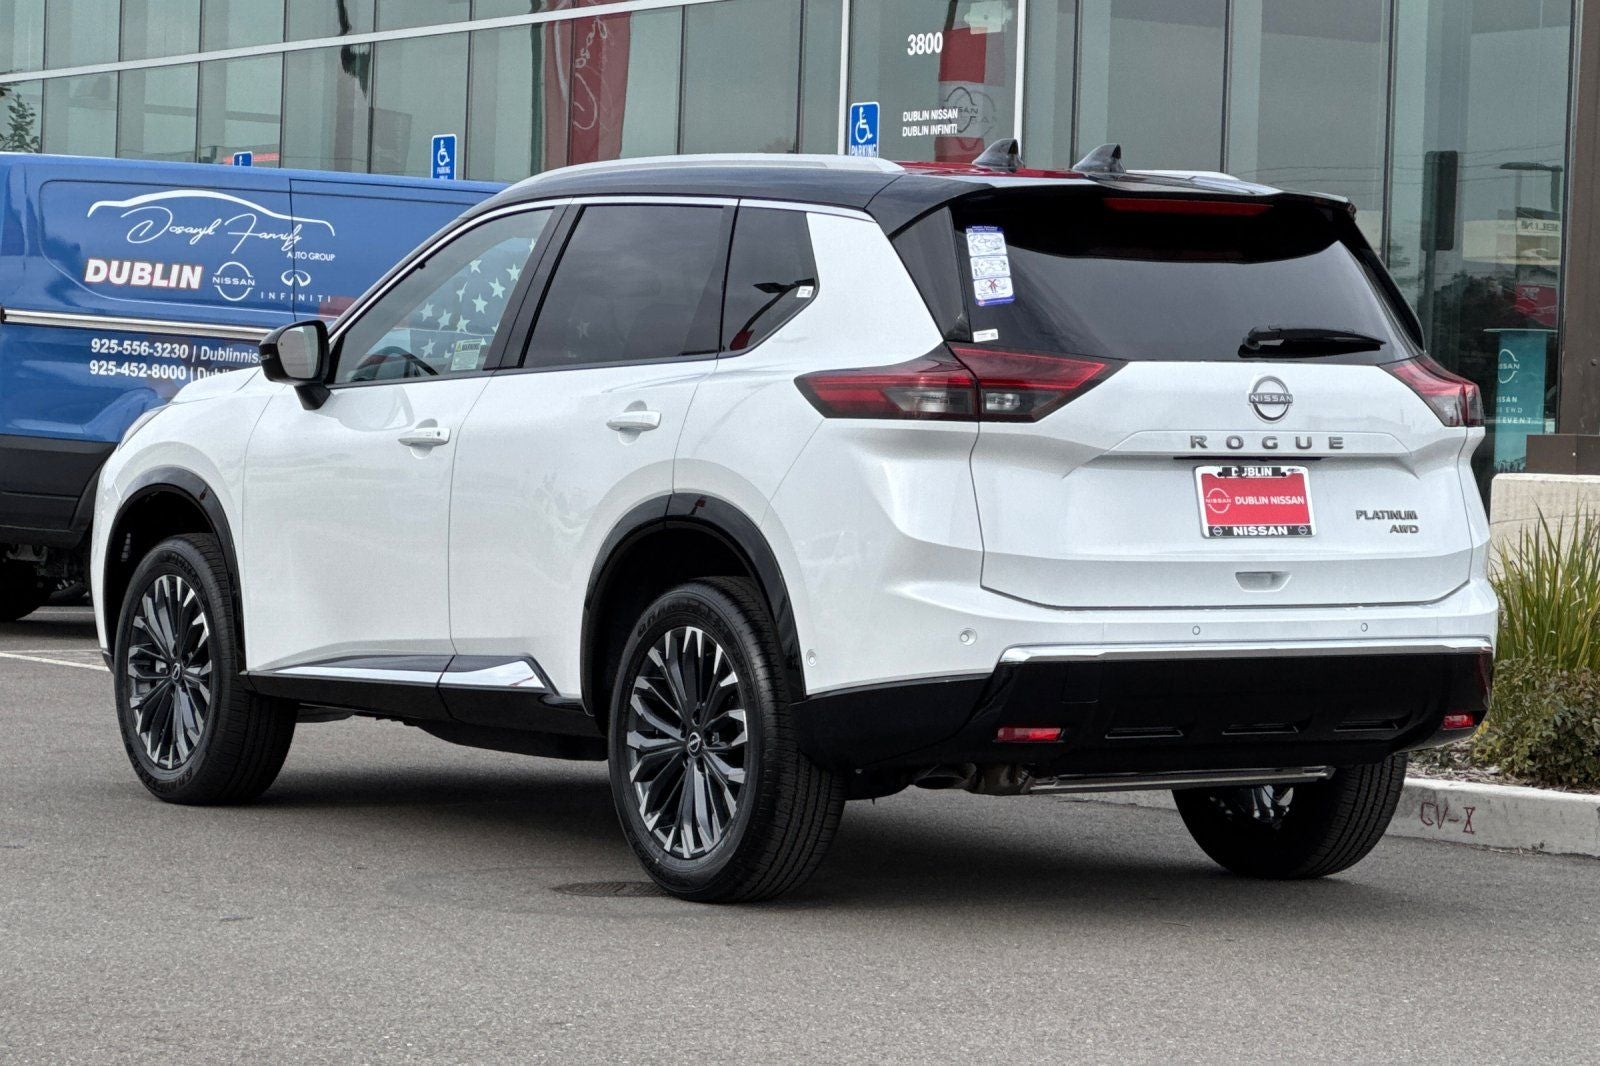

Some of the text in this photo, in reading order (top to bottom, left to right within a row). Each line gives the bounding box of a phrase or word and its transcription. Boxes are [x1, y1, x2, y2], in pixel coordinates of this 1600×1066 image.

[907, 32, 943, 56] 3800
[902, 108, 958, 122] DUBLIN NISSAN
[902, 123, 958, 137] DUBLIN INFINITI
[851, 144, 877, 157] PARKING
[286, 251, 336, 261] AUTO GROUP
[85, 258, 203, 290] DUBLIN
[213, 276, 255, 287] NISSAN
[260, 291, 332, 303] INFINITI
[91, 338, 189, 359] 925-556-3230
[200, 346, 261, 364] Dublinnis
[89, 360, 187, 380] 925-452-8000
[1249, 393, 1292, 402] NISSAN
[1190, 435, 1345, 450] ROGUE
[1234, 496, 1305, 505] DUBLIN NISSAN
[1356, 509, 1418, 521] PLATINUM
[1233, 526, 1288, 536] NISSAN
[1390, 524, 1419, 535] AWD
